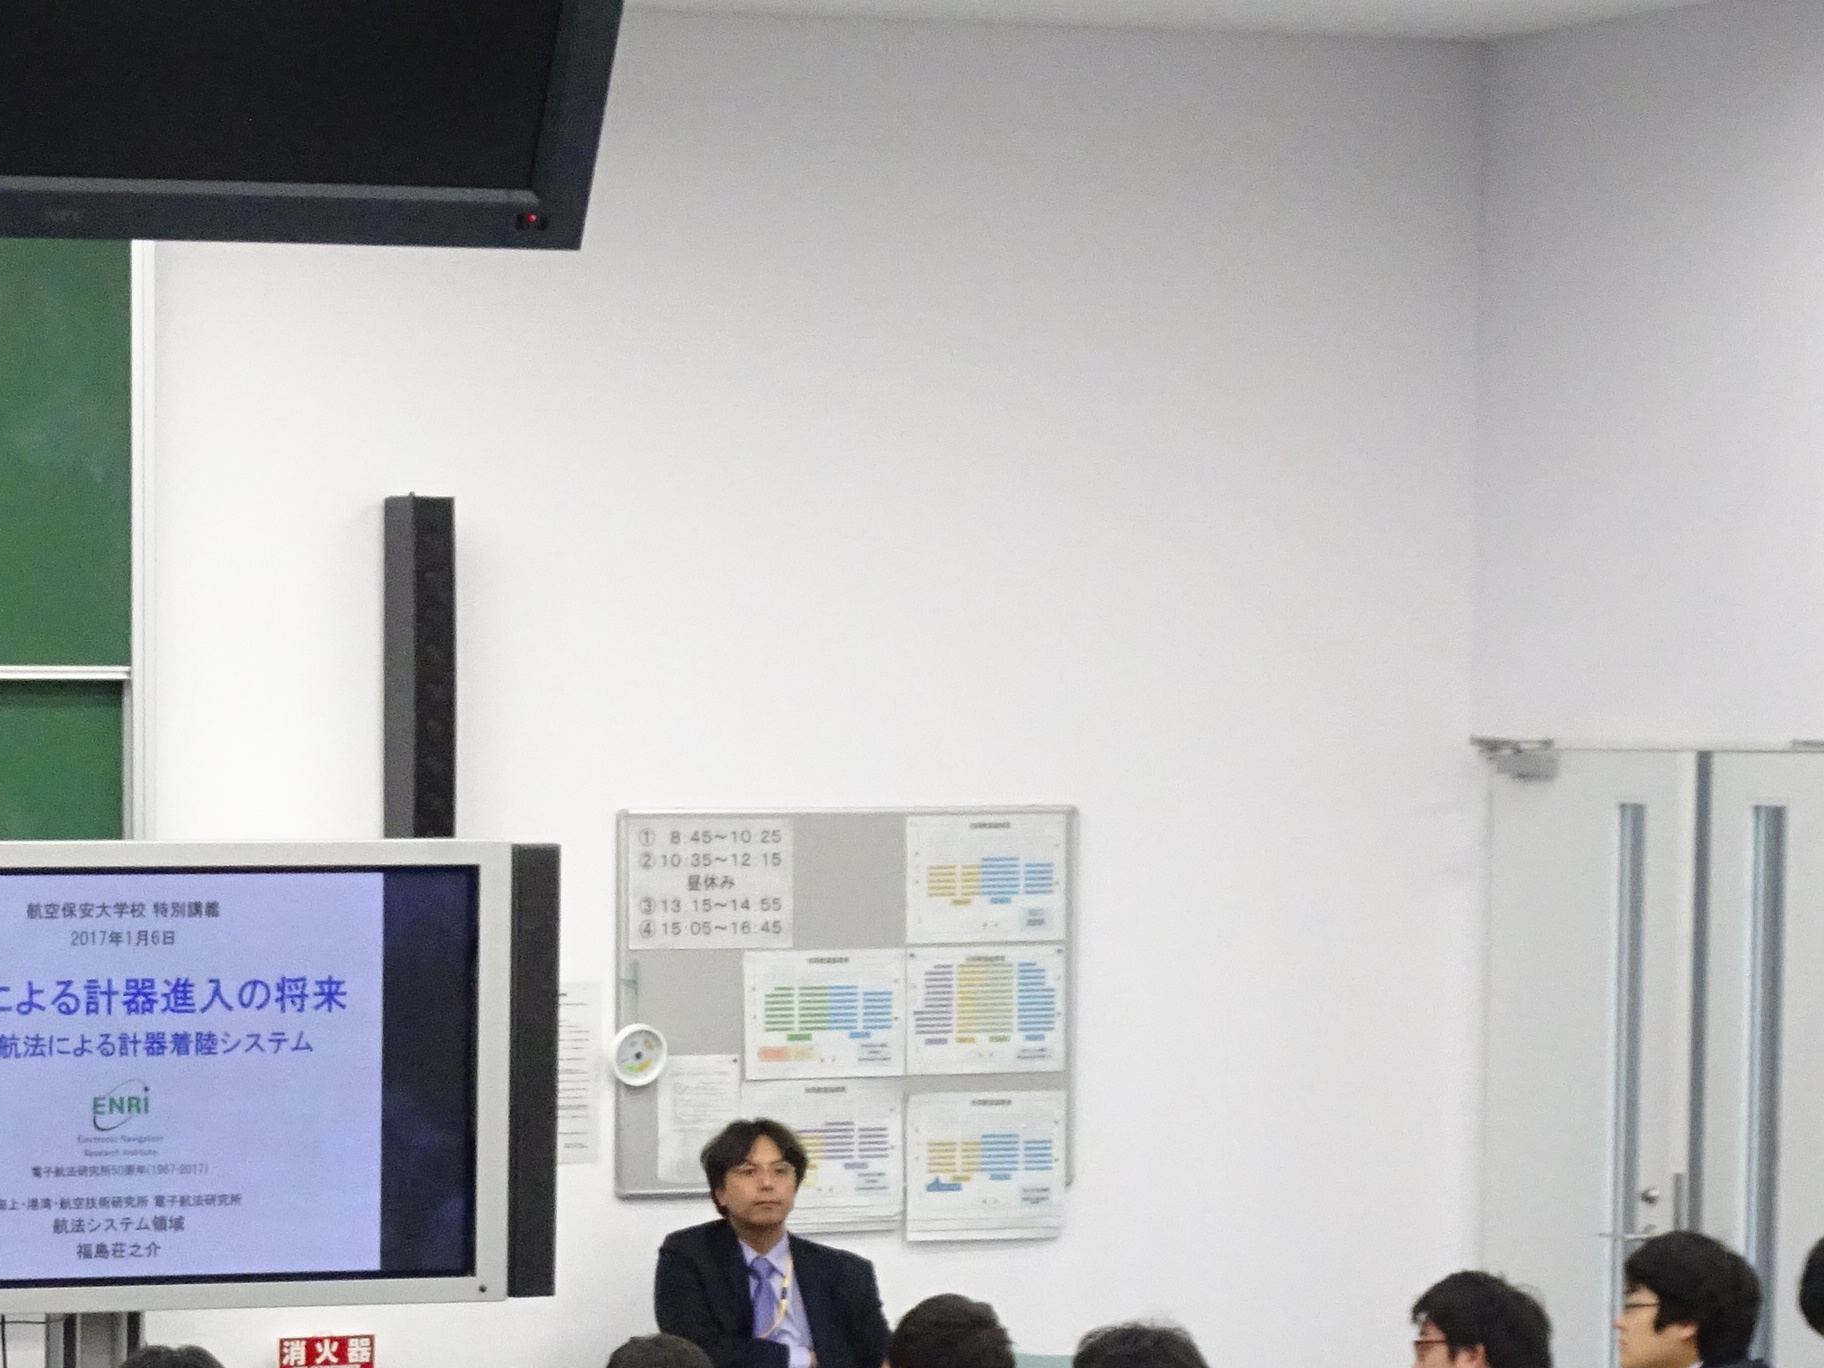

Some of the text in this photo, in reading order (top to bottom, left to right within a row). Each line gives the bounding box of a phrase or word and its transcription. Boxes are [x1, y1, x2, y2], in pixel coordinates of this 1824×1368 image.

[687, 874, 736, 892] 昼休み
[26, 901, 221, 920] 航空保安大学校 特別講義
[70, 929, 176, 947] 2017年1月6日
[53, 1215, 186, 1235] 航法システム領域
[282, 1338, 371, 1366] 消火器
